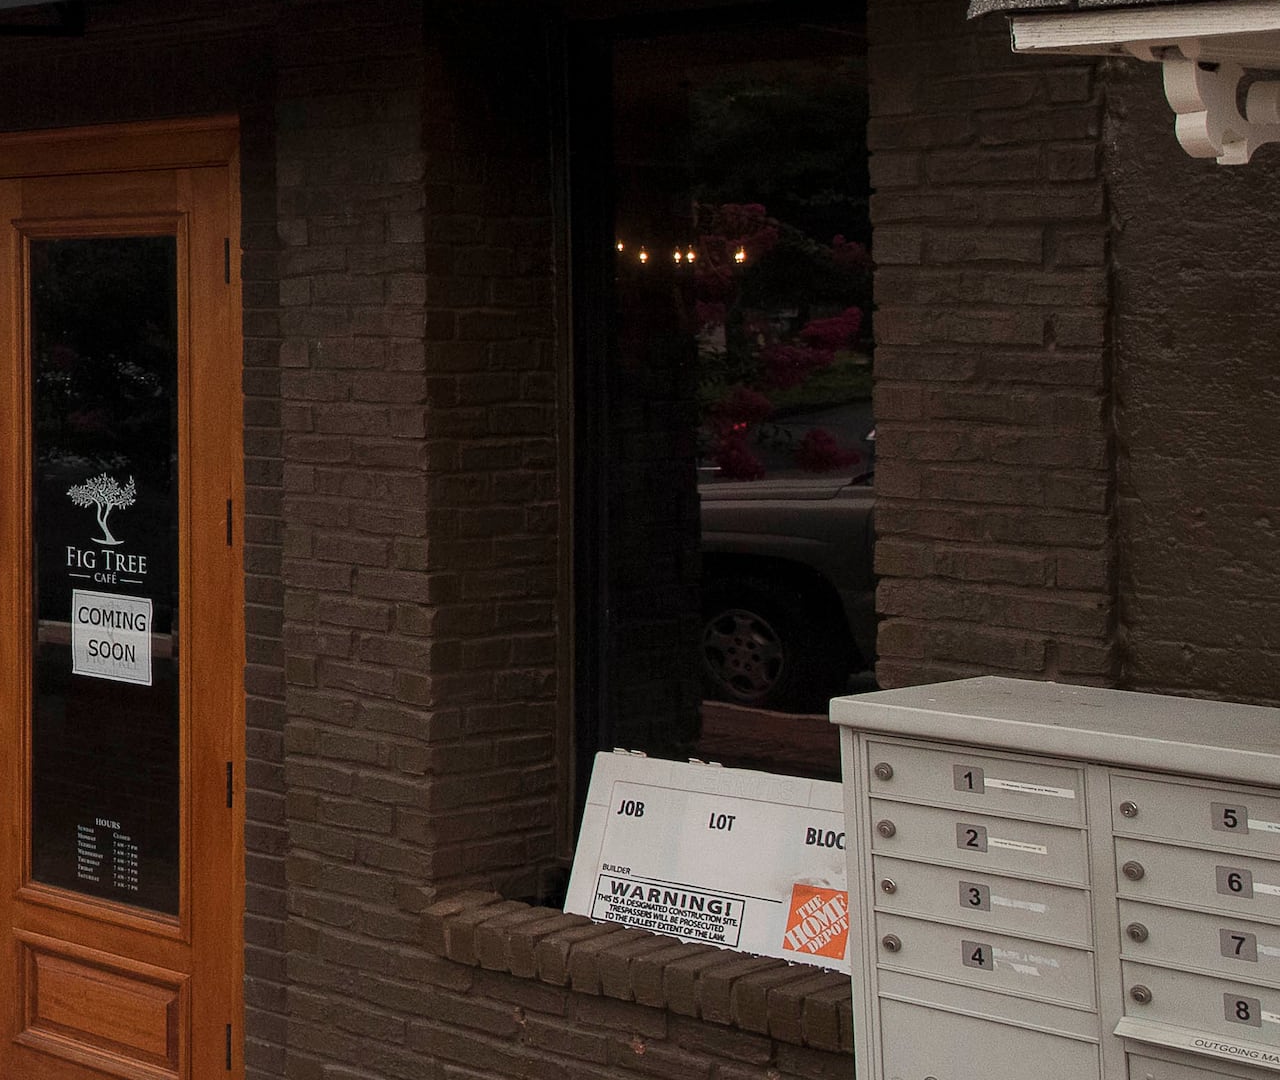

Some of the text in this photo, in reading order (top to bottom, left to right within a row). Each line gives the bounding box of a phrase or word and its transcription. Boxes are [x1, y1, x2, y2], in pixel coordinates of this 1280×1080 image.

[66, 545, 147, 574] FIG TREE
[94, 571, 118, 584] CAFÉ
[78, 606, 147, 632] COMING
[88, 639, 136, 663] SOON
[963, 771, 973, 790] 1
[617, 799, 645, 818] JOB
[1223, 808, 1238, 829] 5
[95, 818, 120, 829] HOURS
[709, 812, 736, 832] LOT
[965, 828, 979, 847] 2
[602, 863, 631, 875] BUILDER
[1227, 872, 1243, 892] 6
[611, 880, 732, 917] WARNING!
[795, 894, 825, 919] THE
[968, 887, 981, 906] 3
[598, 893, 612, 903] THIS
[612, 896, 620, 904] IS
[626, 899, 668, 914] DESIGNATED
[668, 907, 722, 924] CONSTRUCTION
[609, 904, 725, 933] TRESPASSERS WILL BE PROSECUTED
[605, 911, 614, 920] TO
[615, 913, 628, 923] THE
[629, 916, 657, 928] FULLEST
[658, 921, 683, 933] EXTENT
[683, 926, 694, 936] OF
[695, 928, 709, 939] THE
[785, 894, 848, 951] HOME
[806, 916, 848, 953] DEPOT
[1231, 935, 1246, 956] 7
[971, 947, 985, 966] 4
[1235, 1000, 1250, 1021] 8
[1194, 1039, 1260, 1058] OUTGOING
